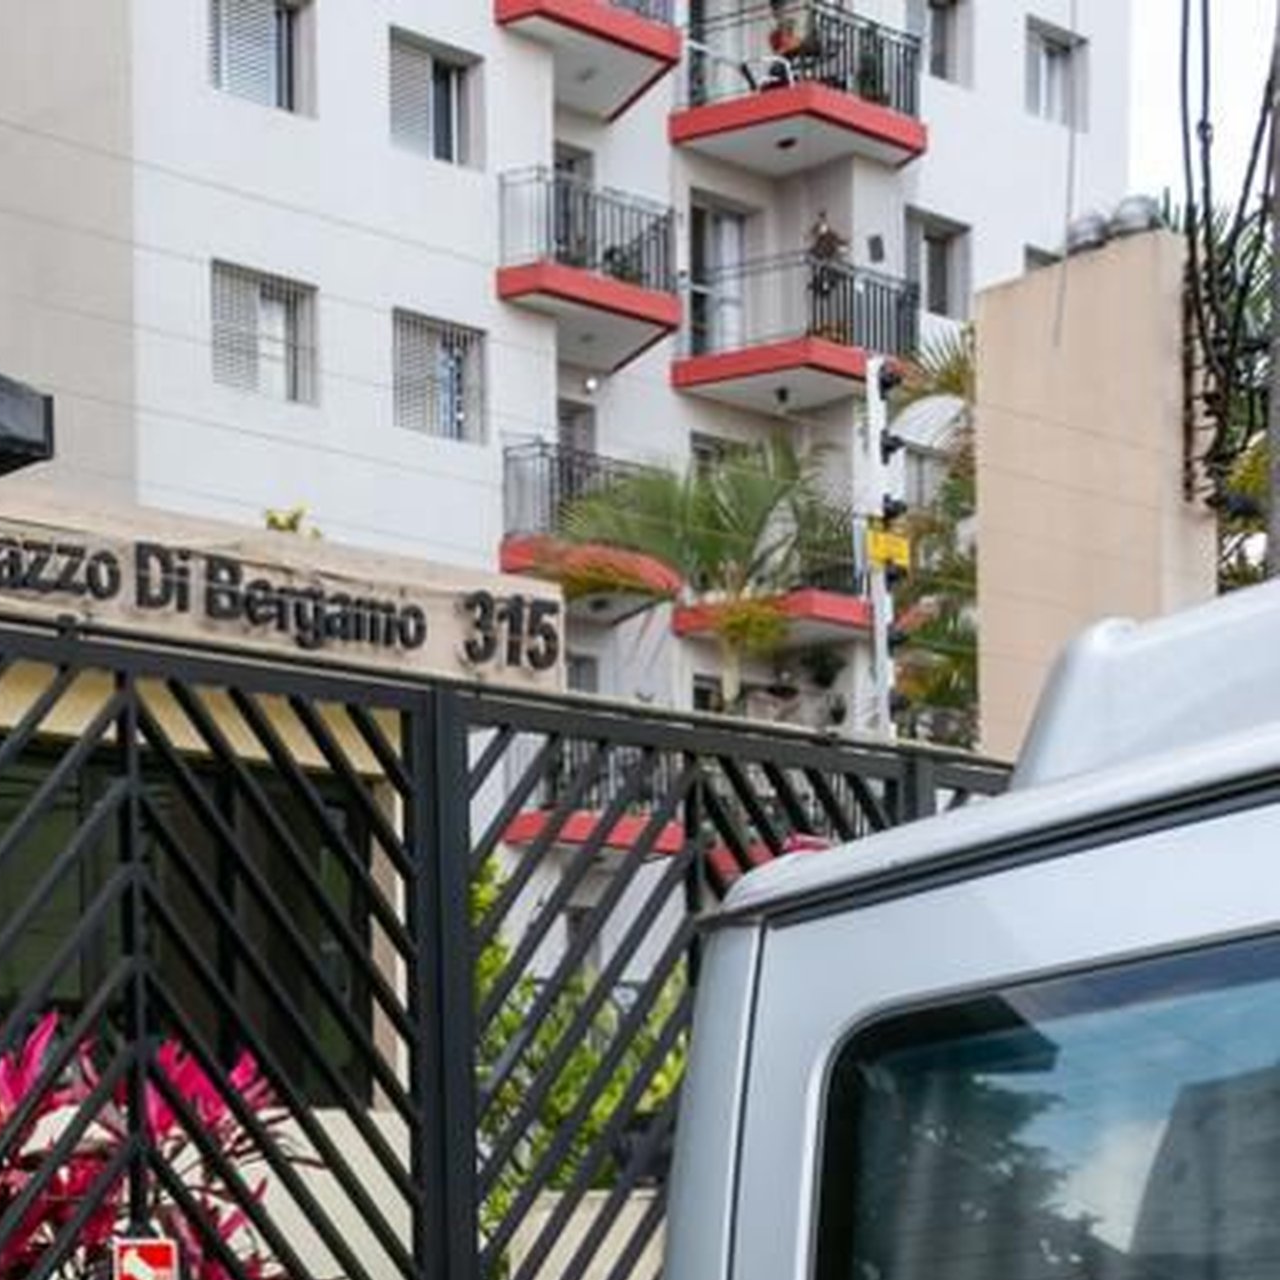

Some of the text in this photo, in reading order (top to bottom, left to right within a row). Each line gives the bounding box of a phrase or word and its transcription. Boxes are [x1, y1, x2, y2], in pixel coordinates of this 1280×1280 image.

[134, 542, 191, 613] Di
[205, 555, 427, 650] Bergamo
[462, 589, 561, 669] 315
